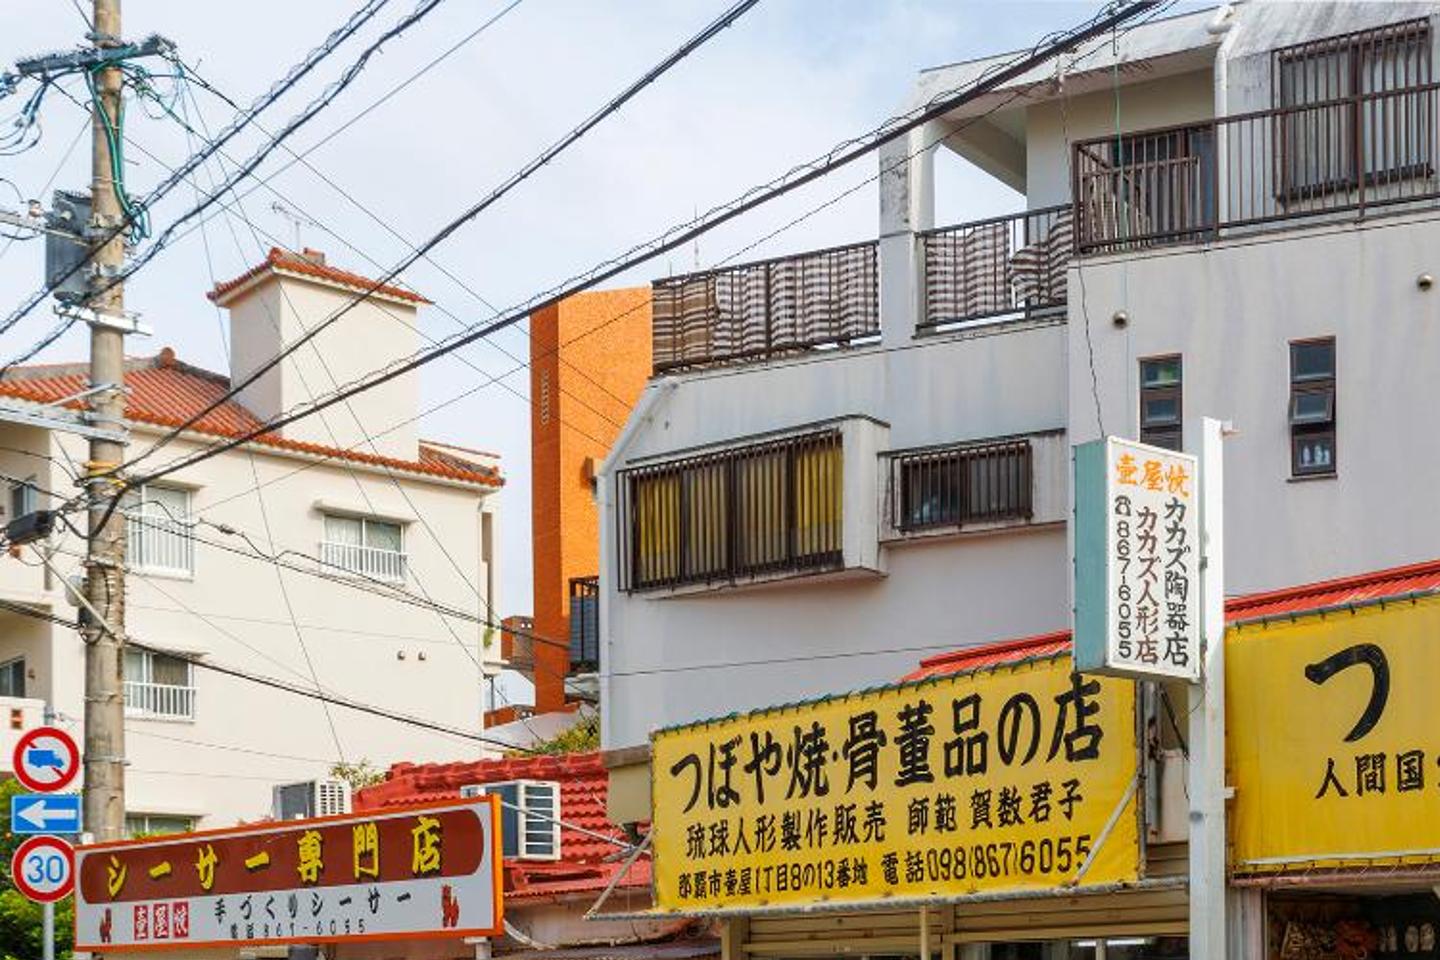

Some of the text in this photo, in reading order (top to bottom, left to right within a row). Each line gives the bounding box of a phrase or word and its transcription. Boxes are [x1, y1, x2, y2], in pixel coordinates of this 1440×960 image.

[1135, 506, 1162, 665] カカズ人形店
[1163, 496, 1191, 667] カカズ陶器店
[106, 815, 442, 899] シーサー専門店
[686, 778, 1083, 860] 琉球人形製作販売 師範 賀数君子
[27, 855, 64, 884] 30
[213, 883, 413, 925] 手づくりシーサー
